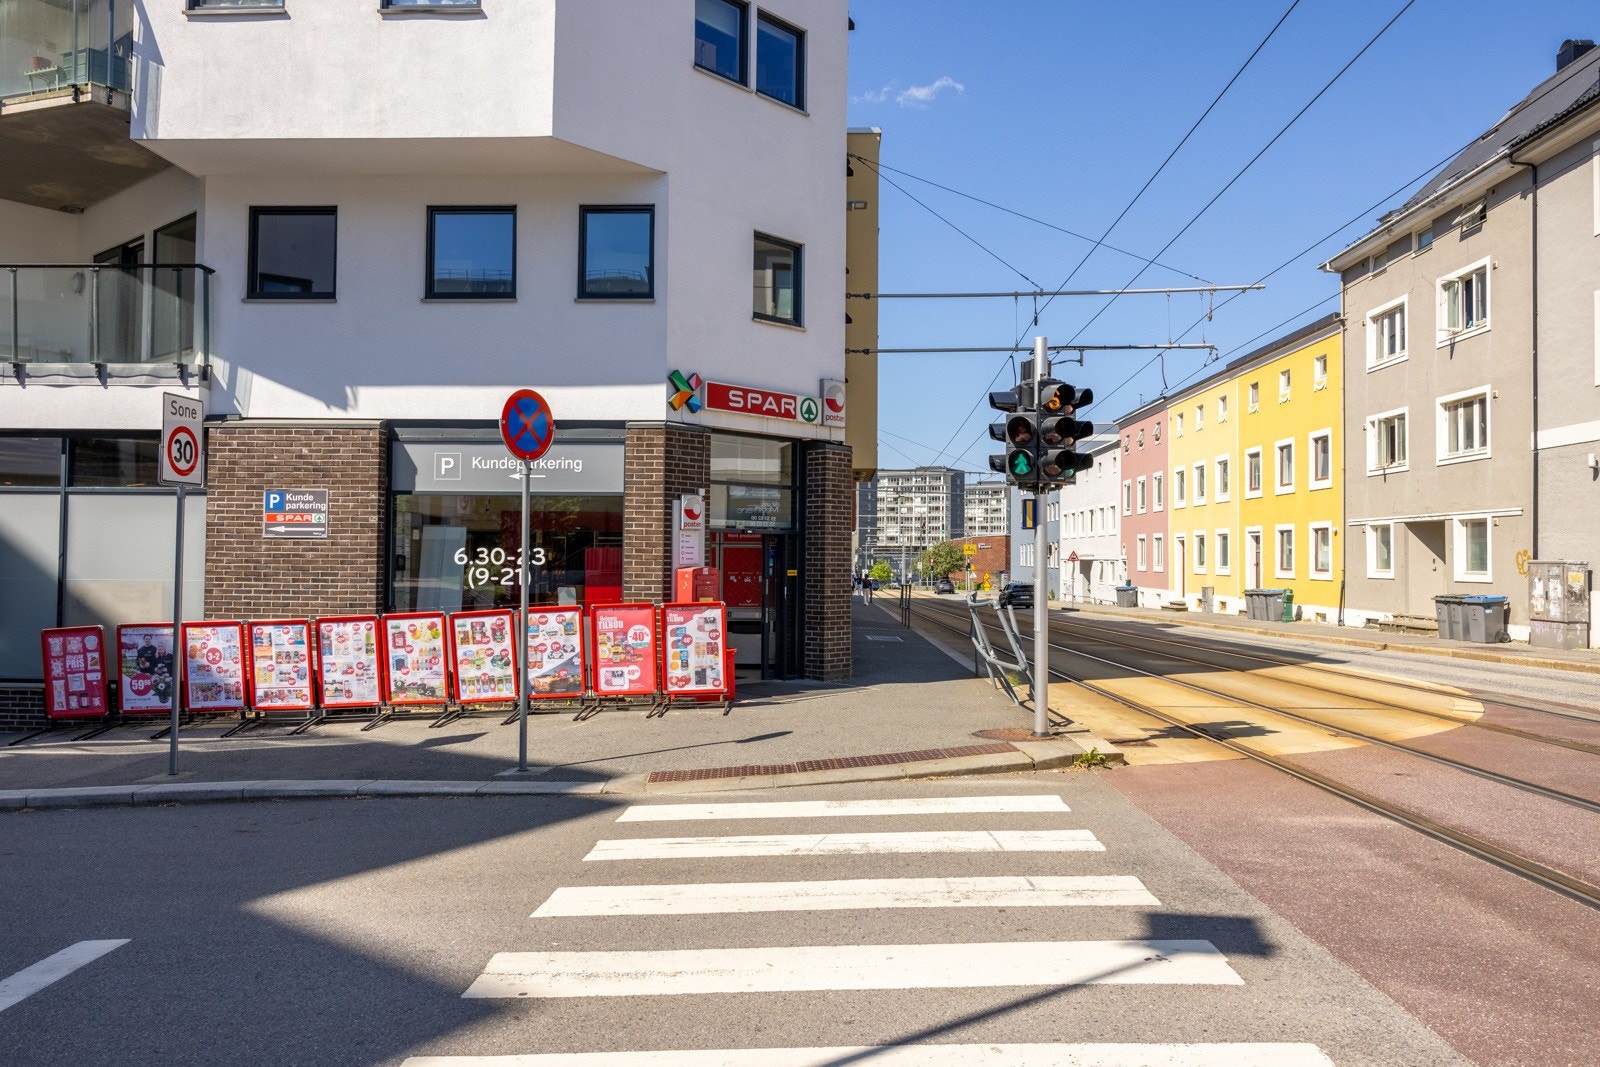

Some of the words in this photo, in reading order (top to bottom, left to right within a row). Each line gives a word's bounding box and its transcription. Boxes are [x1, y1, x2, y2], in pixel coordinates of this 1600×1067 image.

[170, 399, 197, 419] Sone
[728, 389, 796, 416] SPAR
[173, 438, 194, 464] 30
[285, 501, 326, 511] parkering
[286, 493, 314, 501] Kunde
[276, 514, 312, 522] SPAR
[453, 547, 546, 566] 6.30-23
[468, 566, 532, 590] (9-21)
[66, 658, 85, 669] PRIS
